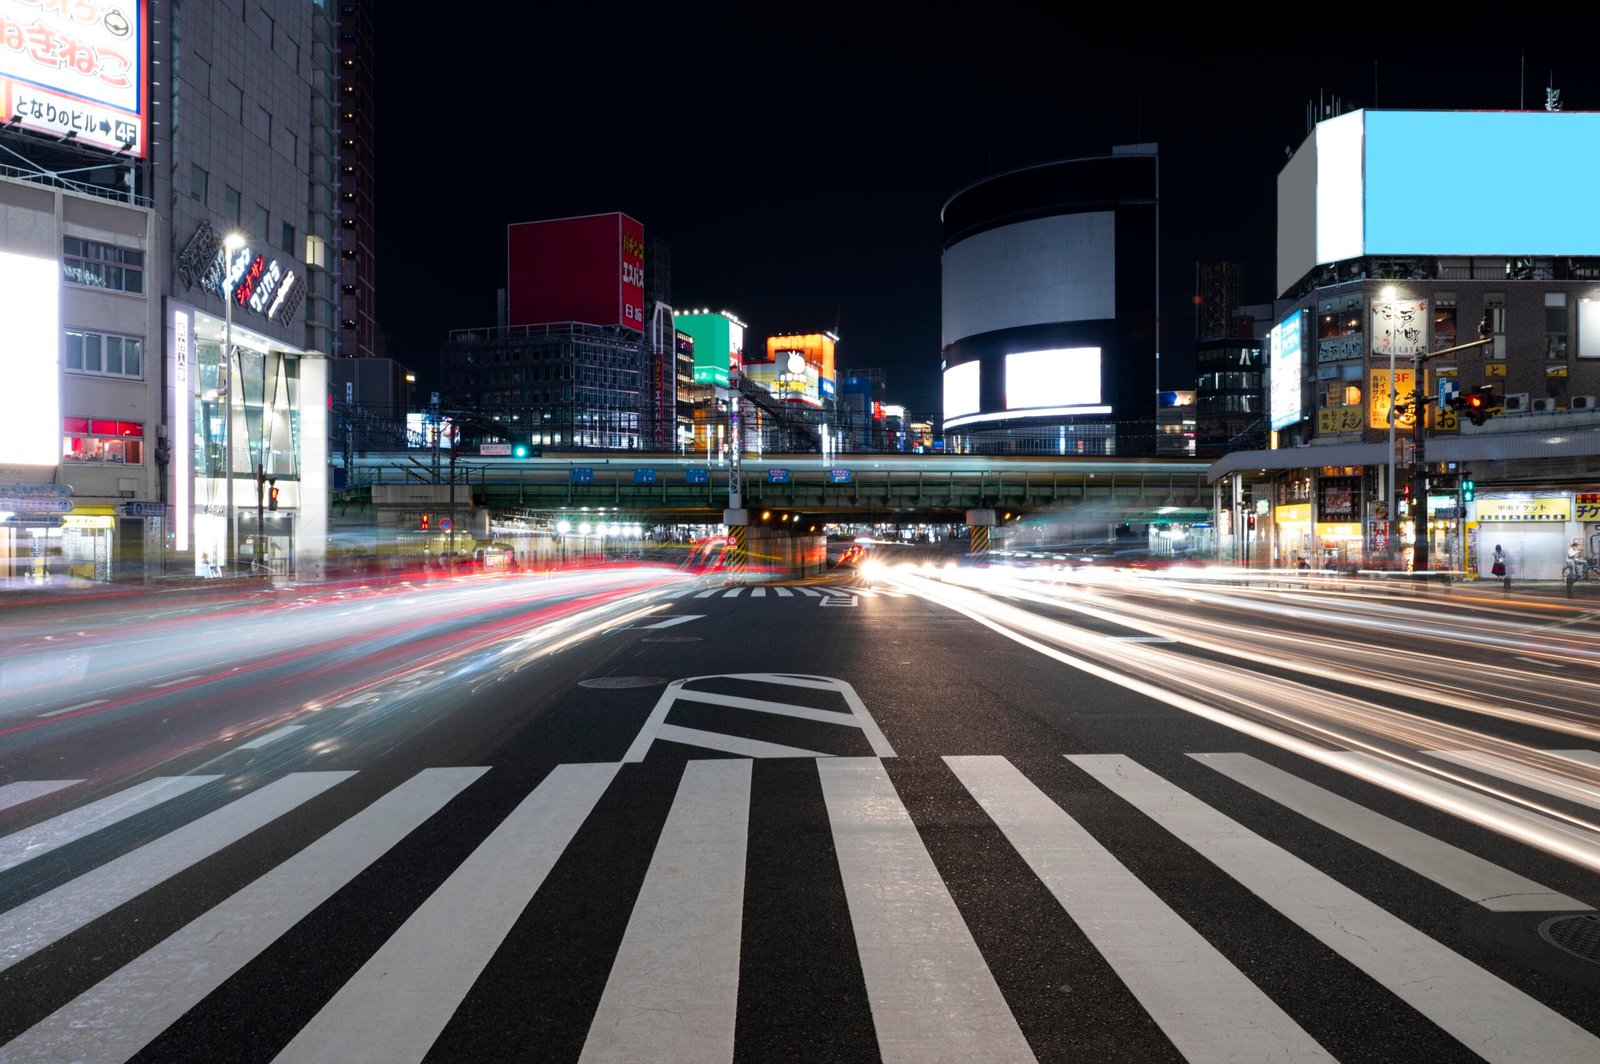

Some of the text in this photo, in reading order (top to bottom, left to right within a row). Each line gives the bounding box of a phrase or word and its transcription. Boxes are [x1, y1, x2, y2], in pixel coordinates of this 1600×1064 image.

[16, 95, 97, 133] となりのビル
[116, 122, 136, 143] 4F
[249, 259, 280, 312] ワンカラ
[623, 261, 644, 288] エスパス
[1379, 375, 1387, 409] ハイボール
